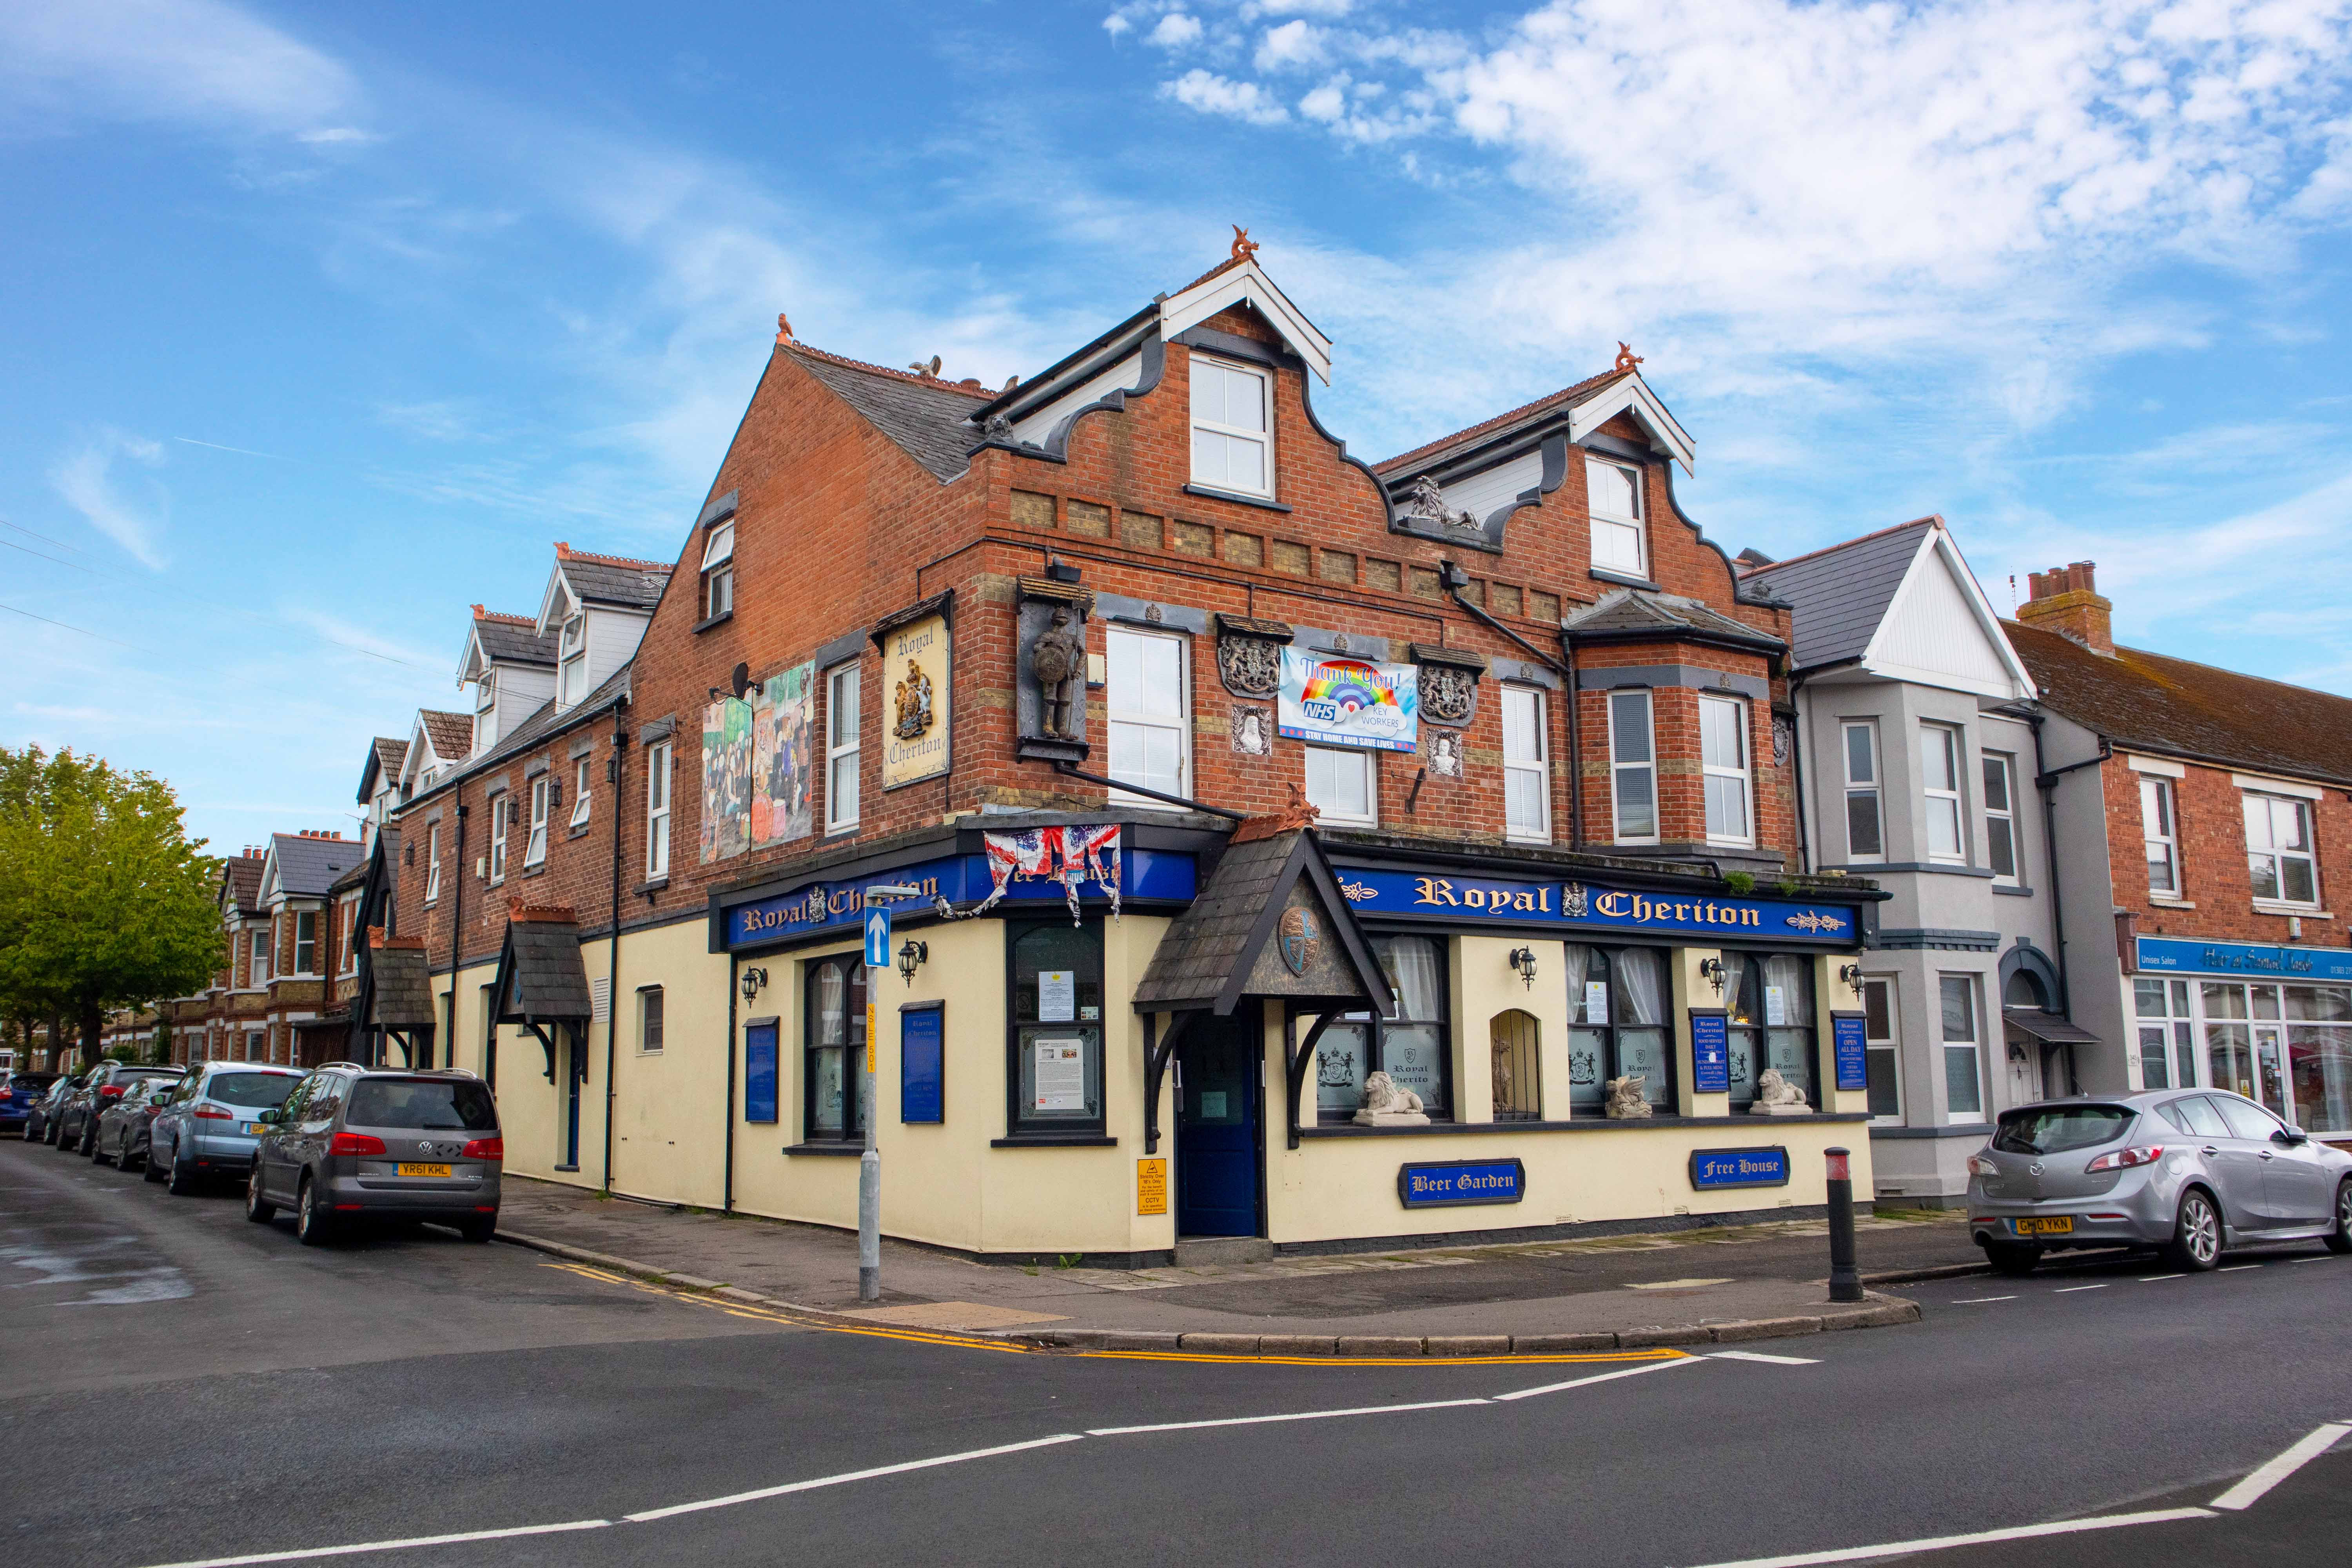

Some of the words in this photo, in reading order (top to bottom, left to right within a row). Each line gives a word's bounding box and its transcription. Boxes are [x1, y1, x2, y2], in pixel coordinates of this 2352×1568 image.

[897, 626, 933, 663] Royal
[1300, 657, 1353, 685] Thank
[1357, 668, 1401, 691] You!
[1304, 702, 1335, 720] NHS
[1373, 706, 1387, 716] KEY
[1361, 717, 1399, 728] WORKERS
[1305, 730, 1321, 740] STAY
[1323, 733, 1343, 744] HOME
[1343, 735, 1359, 745] AND
[1359, 737, 1377, 748] SAVE
[1377, 739, 1394, 750] LIVES
[889, 736, 941, 767] Cheriton
[743, 899, 808, 932] Royal
[828, 877, 938, 915] Chiton
[1414, 878, 1551, 914] Royal
[1595, 892, 1760, 926] Cheriton
[2141, 955, 2160, 965] Unisex
[2161, 956, 2176, 965] Salon
[403, 1164, 425, 1174] YR61
[428, 1165, 447, 1174] KHL
[1704, 1161, 1735, 1178] Free
[1739, 1159, 1779, 1175] House
[1412, 1176, 1452, 1194] Beer
[1457, 1174, 1514, 1190] Garden
[2020, 1220, 2044, 1231] G0
[2046, 1218, 2068, 1230] YKN
